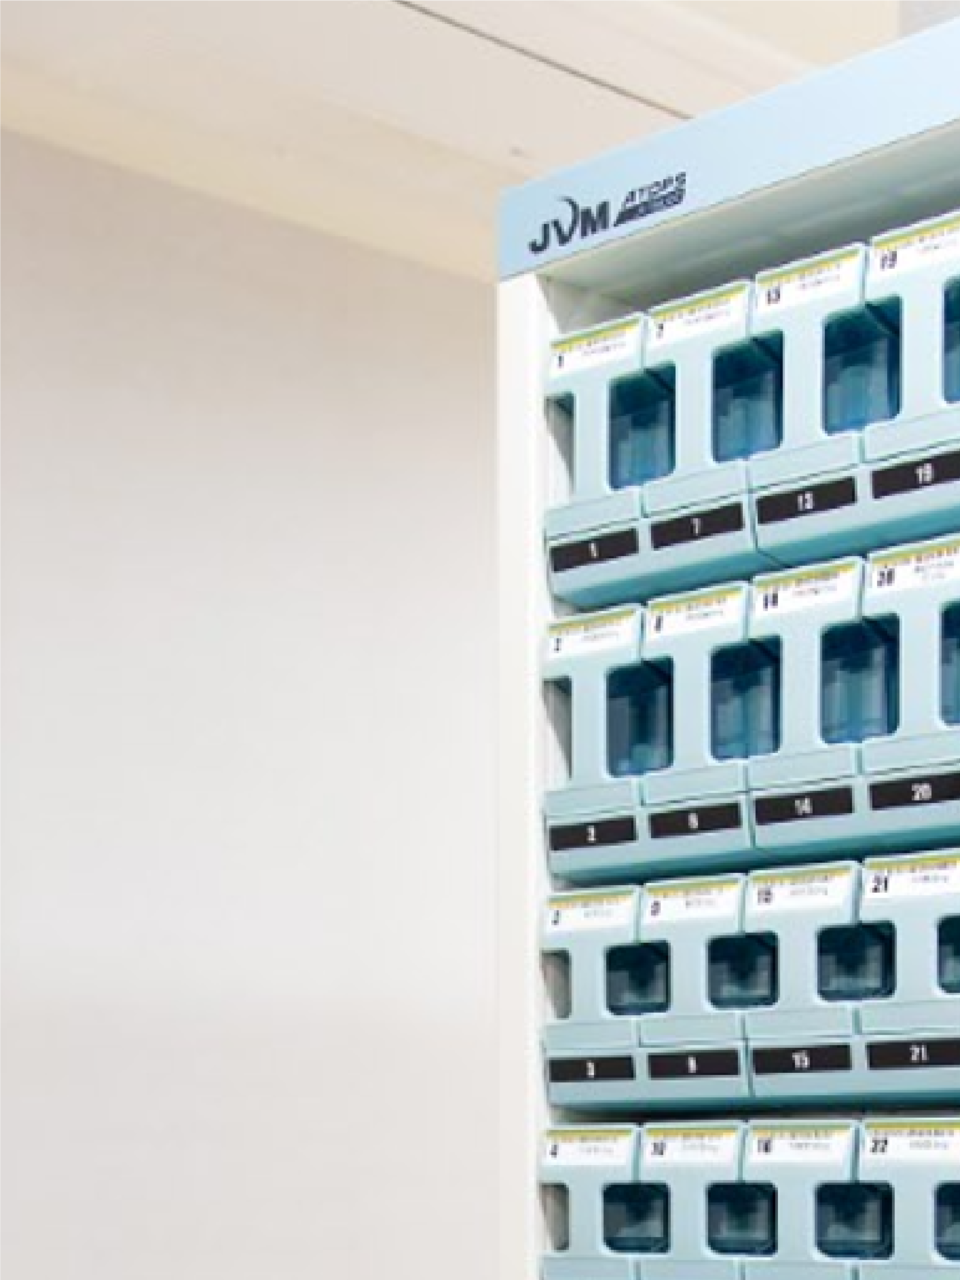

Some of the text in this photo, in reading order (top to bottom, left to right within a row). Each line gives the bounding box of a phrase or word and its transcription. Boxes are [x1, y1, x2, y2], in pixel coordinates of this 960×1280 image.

[529, 194, 610, 253] JVM
[871, 873, 889, 892] 21
[910, 1045, 928, 1062] 21
